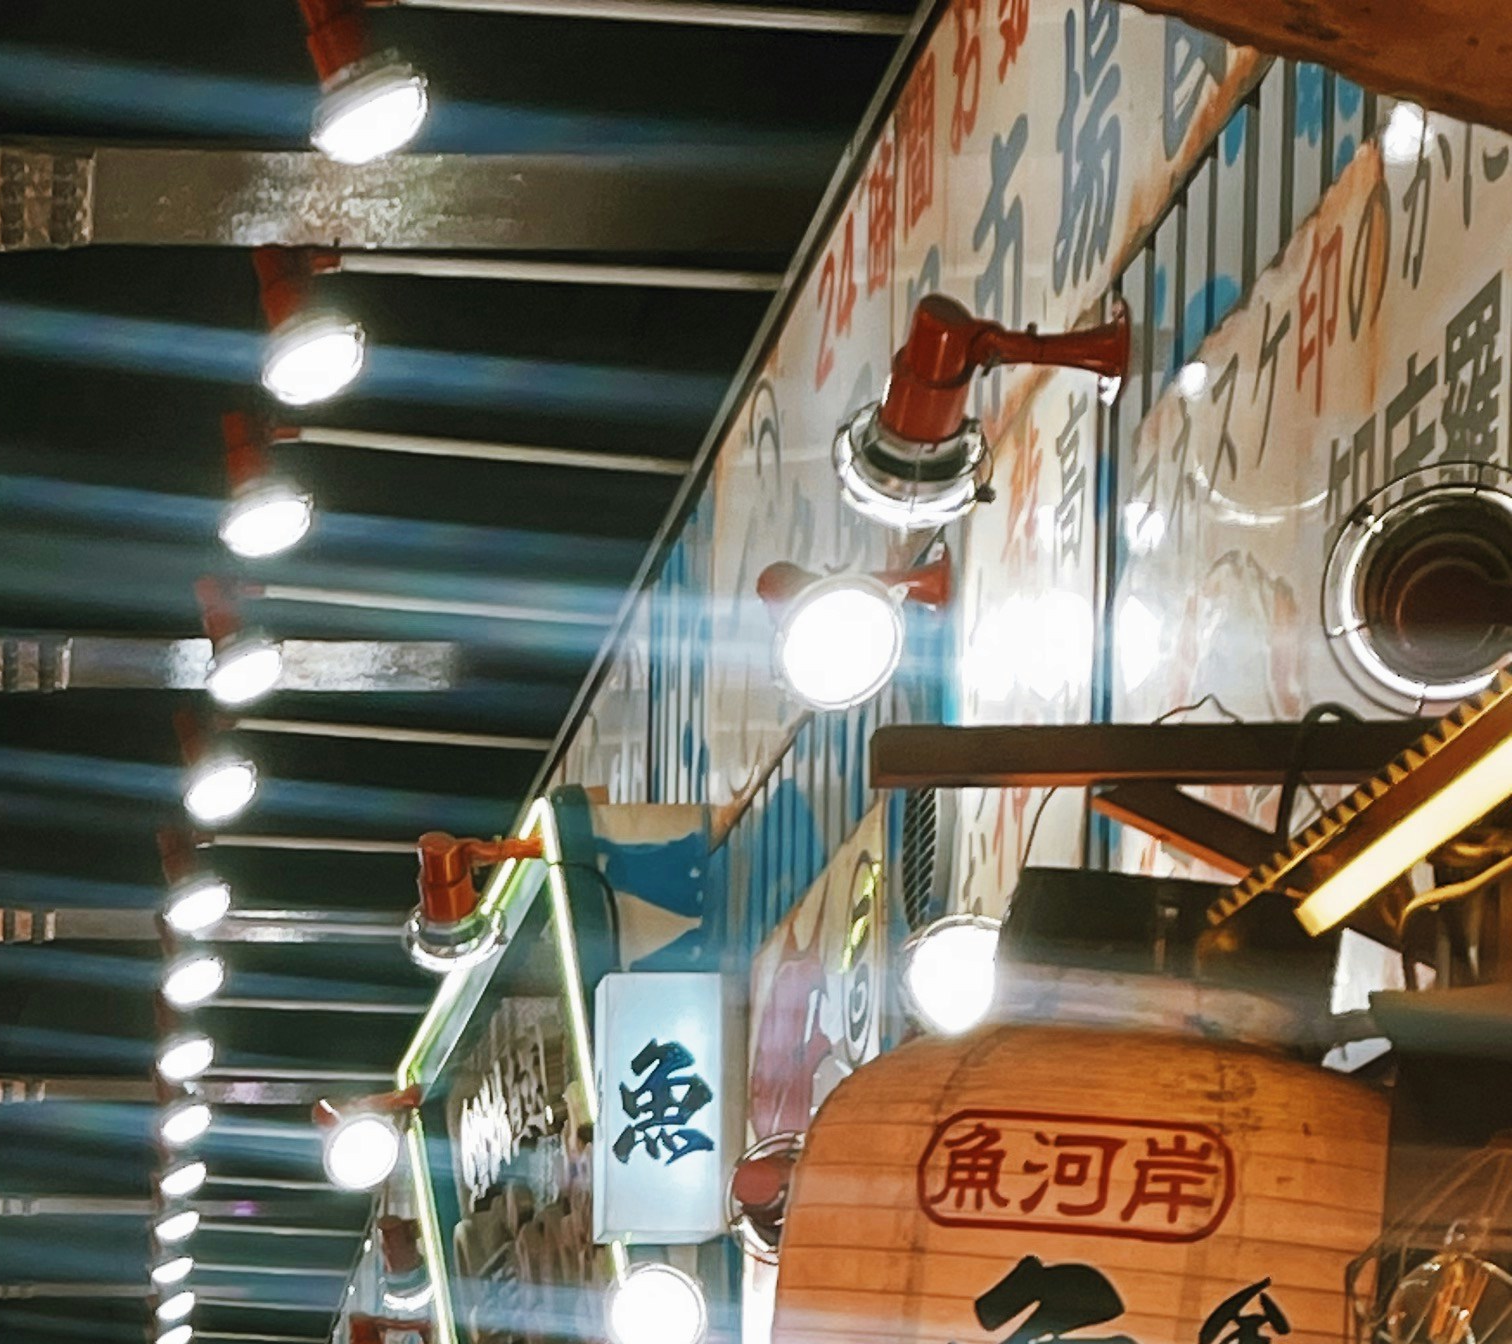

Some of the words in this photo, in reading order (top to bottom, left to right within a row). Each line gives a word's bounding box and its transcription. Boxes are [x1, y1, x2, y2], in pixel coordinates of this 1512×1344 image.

[613, 1038, 715, 1166] 魚
[932, 1124, 1222, 1221] 魚河岸
